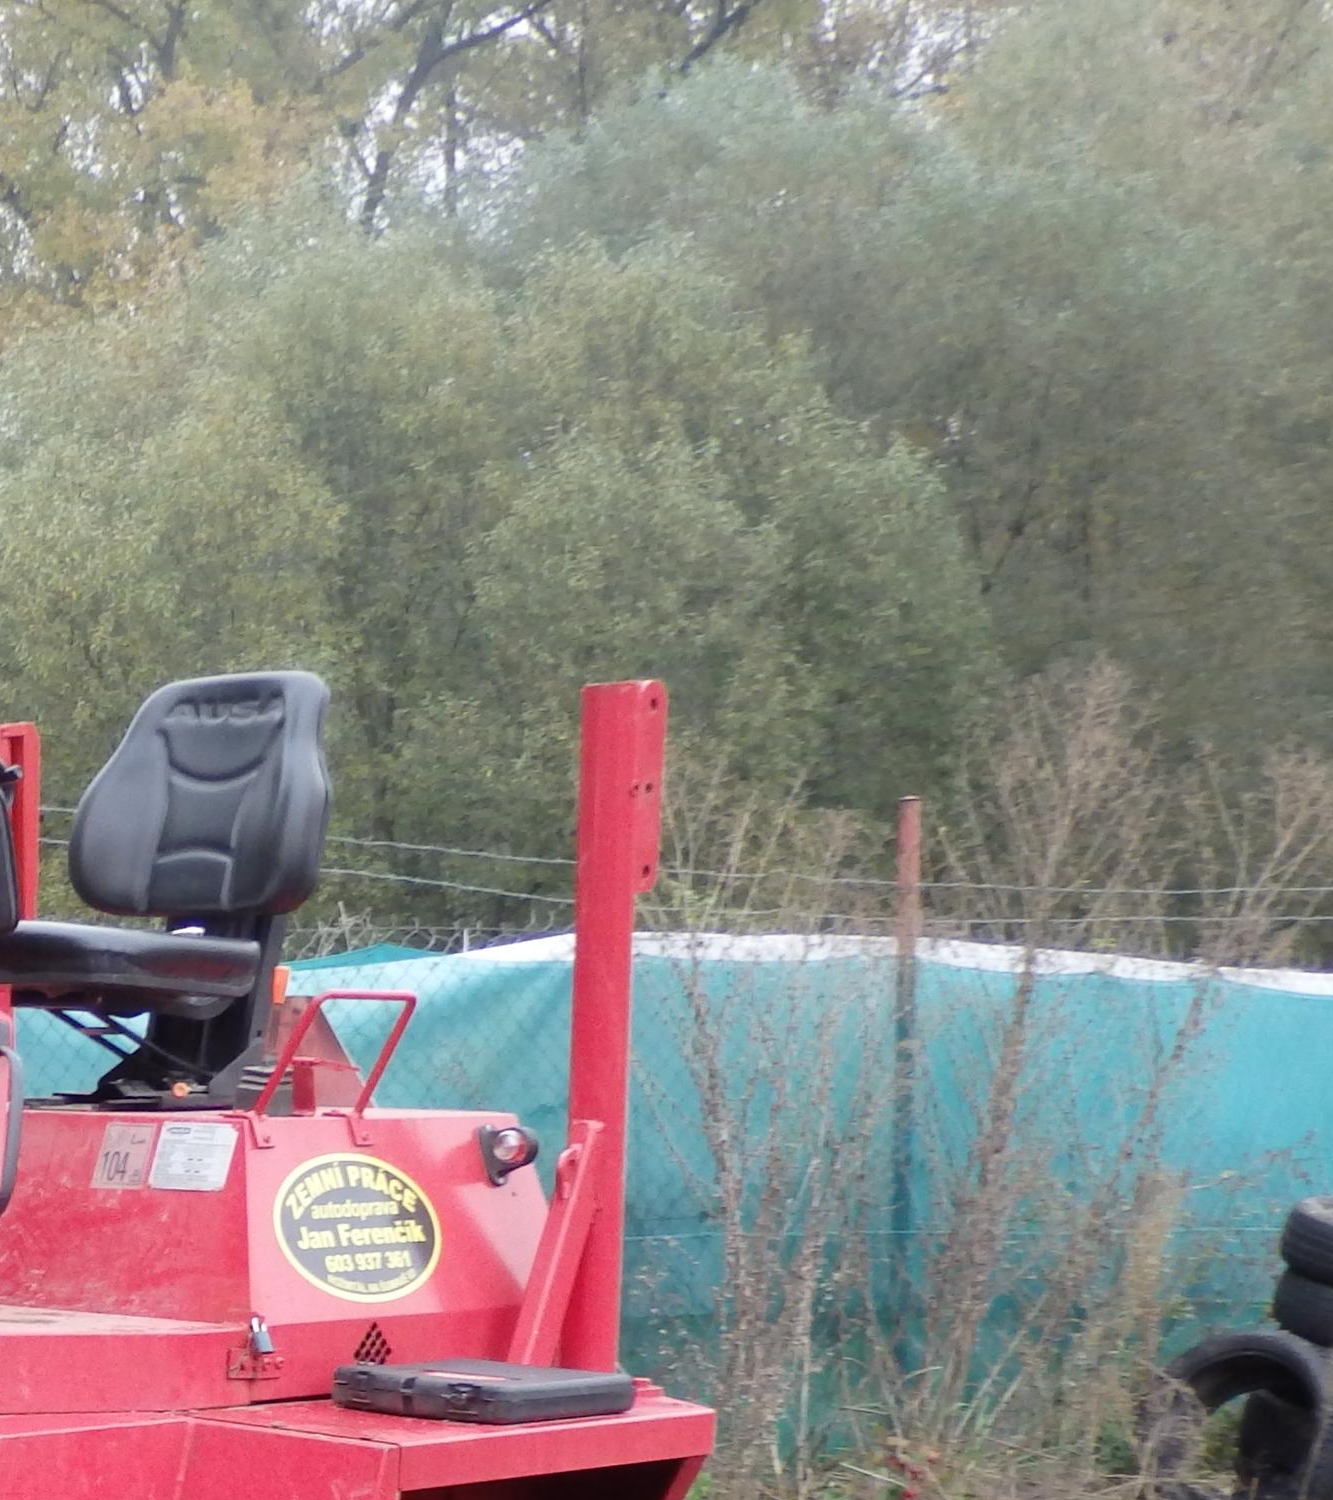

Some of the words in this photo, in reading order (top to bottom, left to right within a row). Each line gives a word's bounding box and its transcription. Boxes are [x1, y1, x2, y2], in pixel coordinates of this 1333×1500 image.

[100, 1151, 130, 1181] 104
[285, 1161, 345, 1220] ZEMNÍ
[347, 1165, 418, 1213] PRÁCE
[310, 1199, 399, 1221] autodoprava
[296, 1226, 336, 1250] Jan
